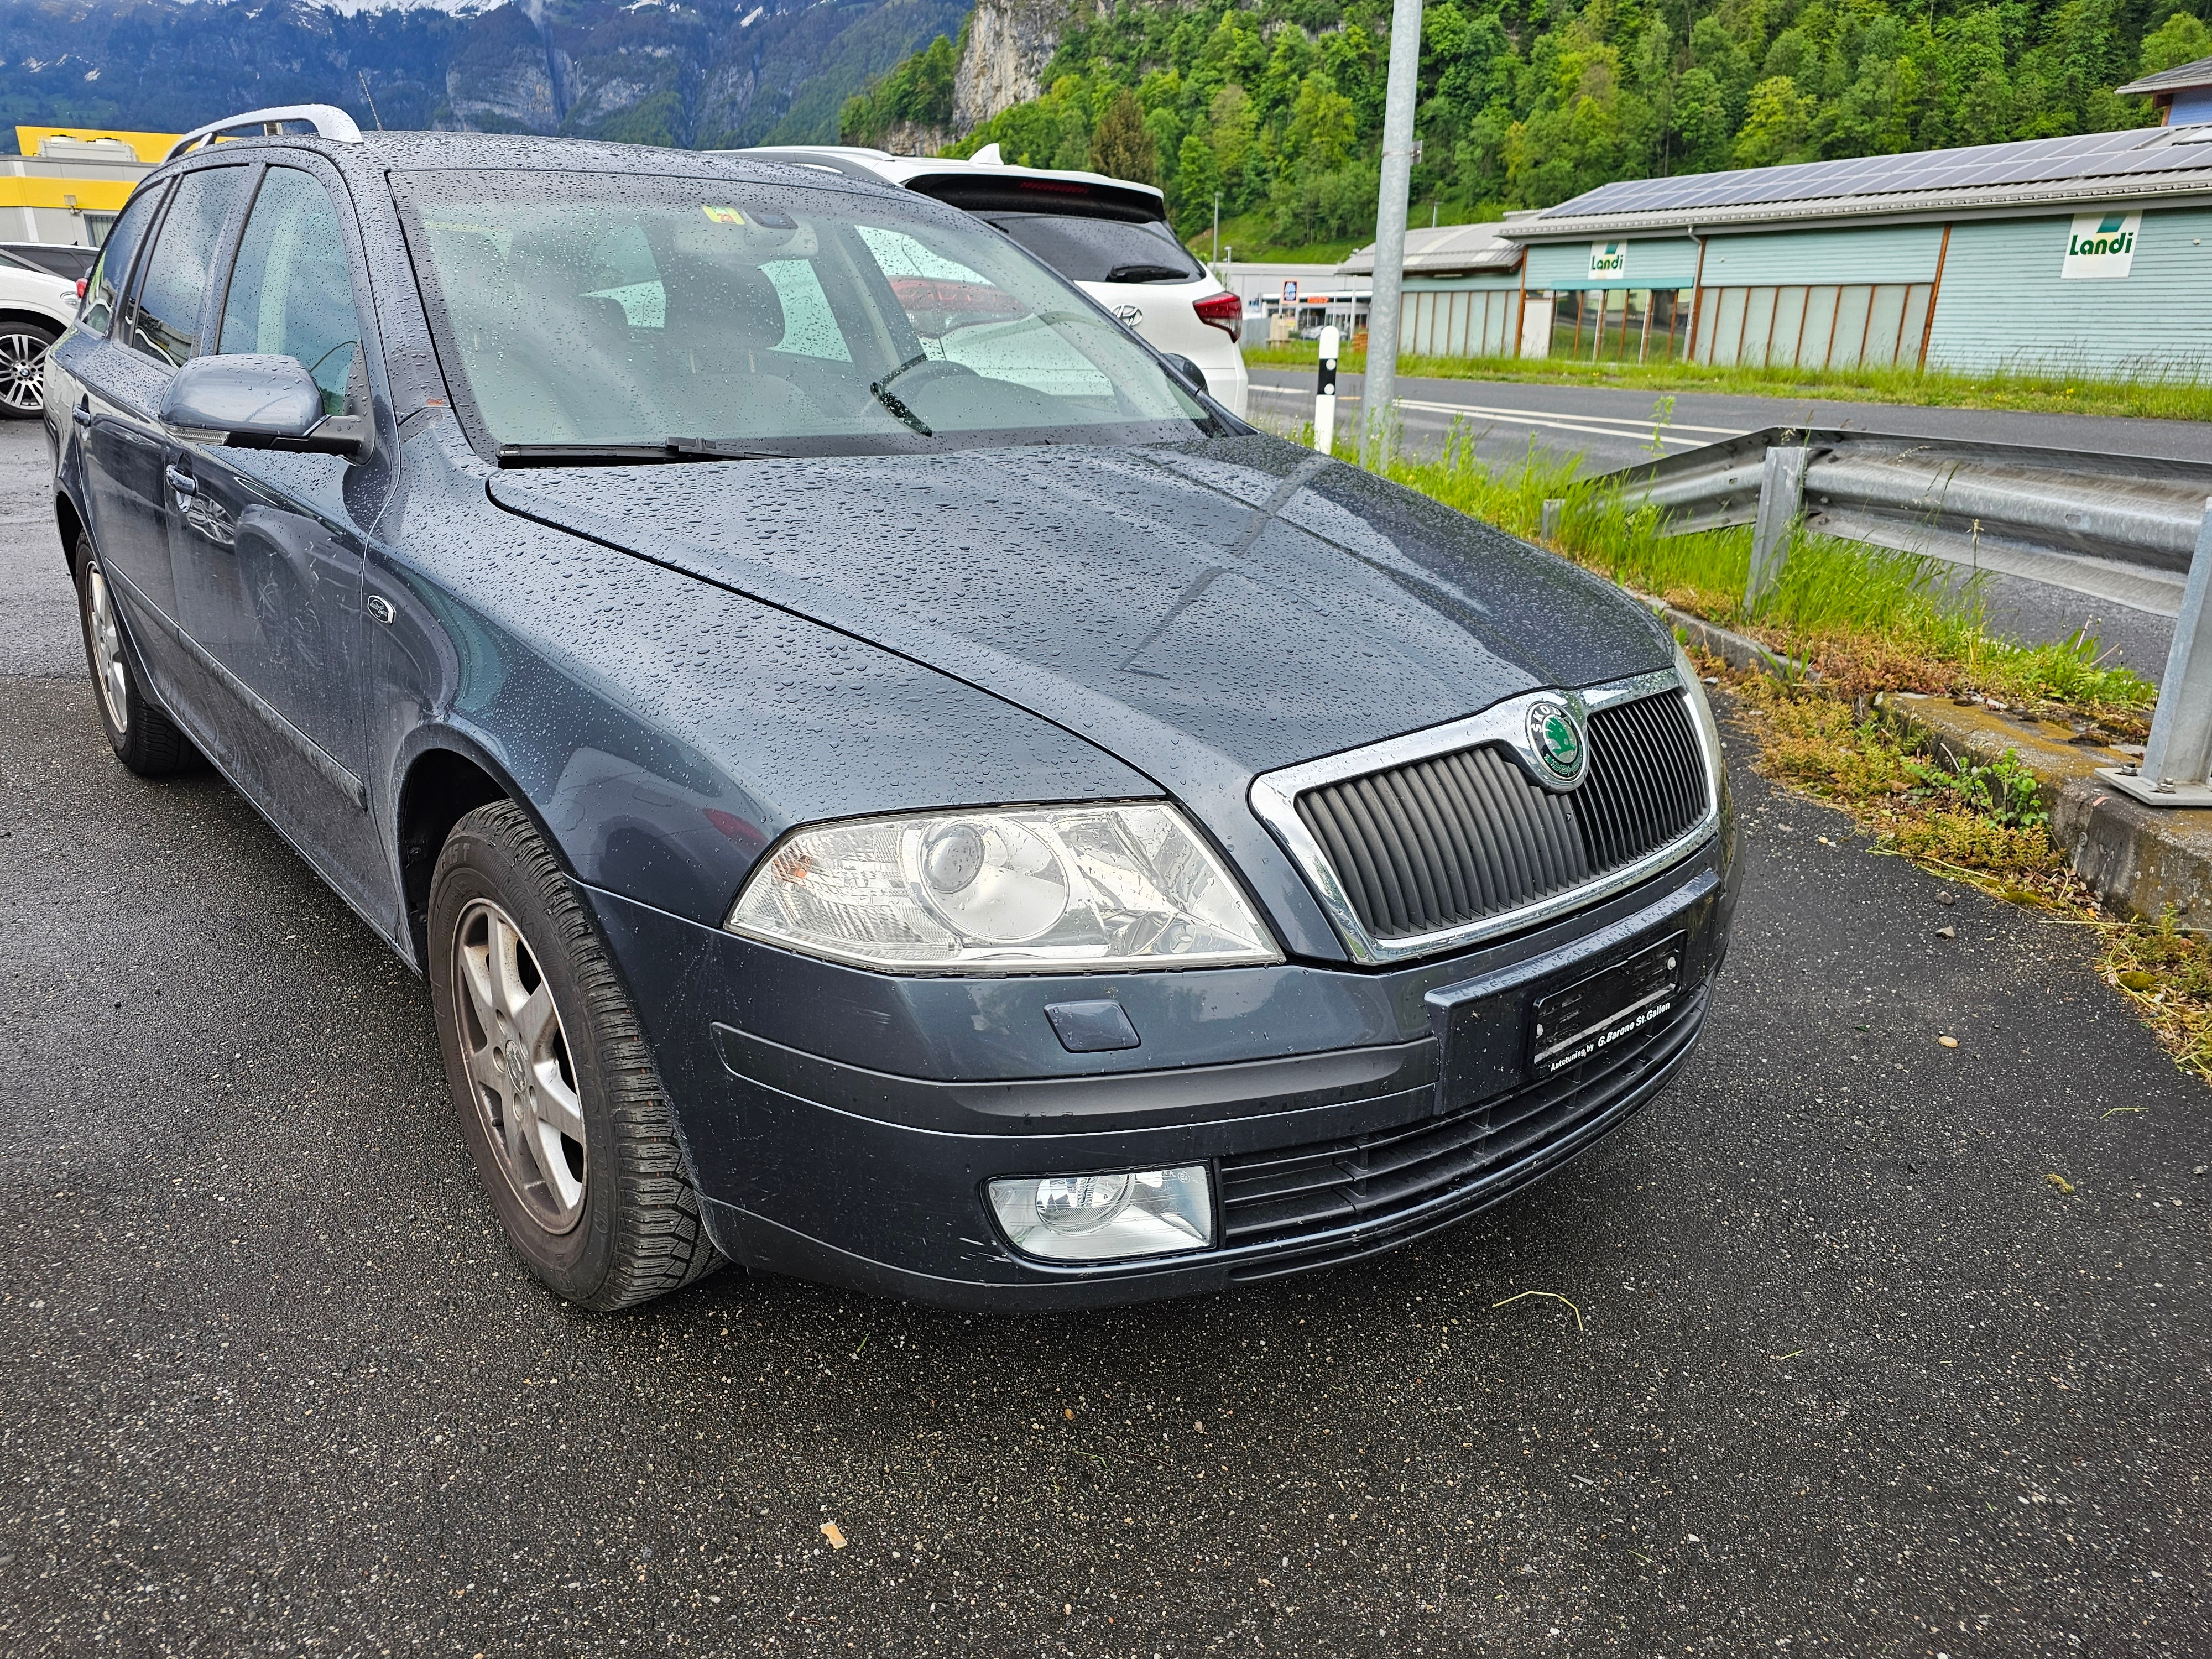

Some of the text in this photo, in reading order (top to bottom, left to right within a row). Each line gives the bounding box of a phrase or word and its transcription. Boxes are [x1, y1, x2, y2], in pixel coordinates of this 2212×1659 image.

[2069, 232, 2134, 255] Landi
[1592, 254, 1623, 270] Landi
[1550, 1048, 1586, 1072] Autotuning
[1587, 1044, 1594, 1052] by
